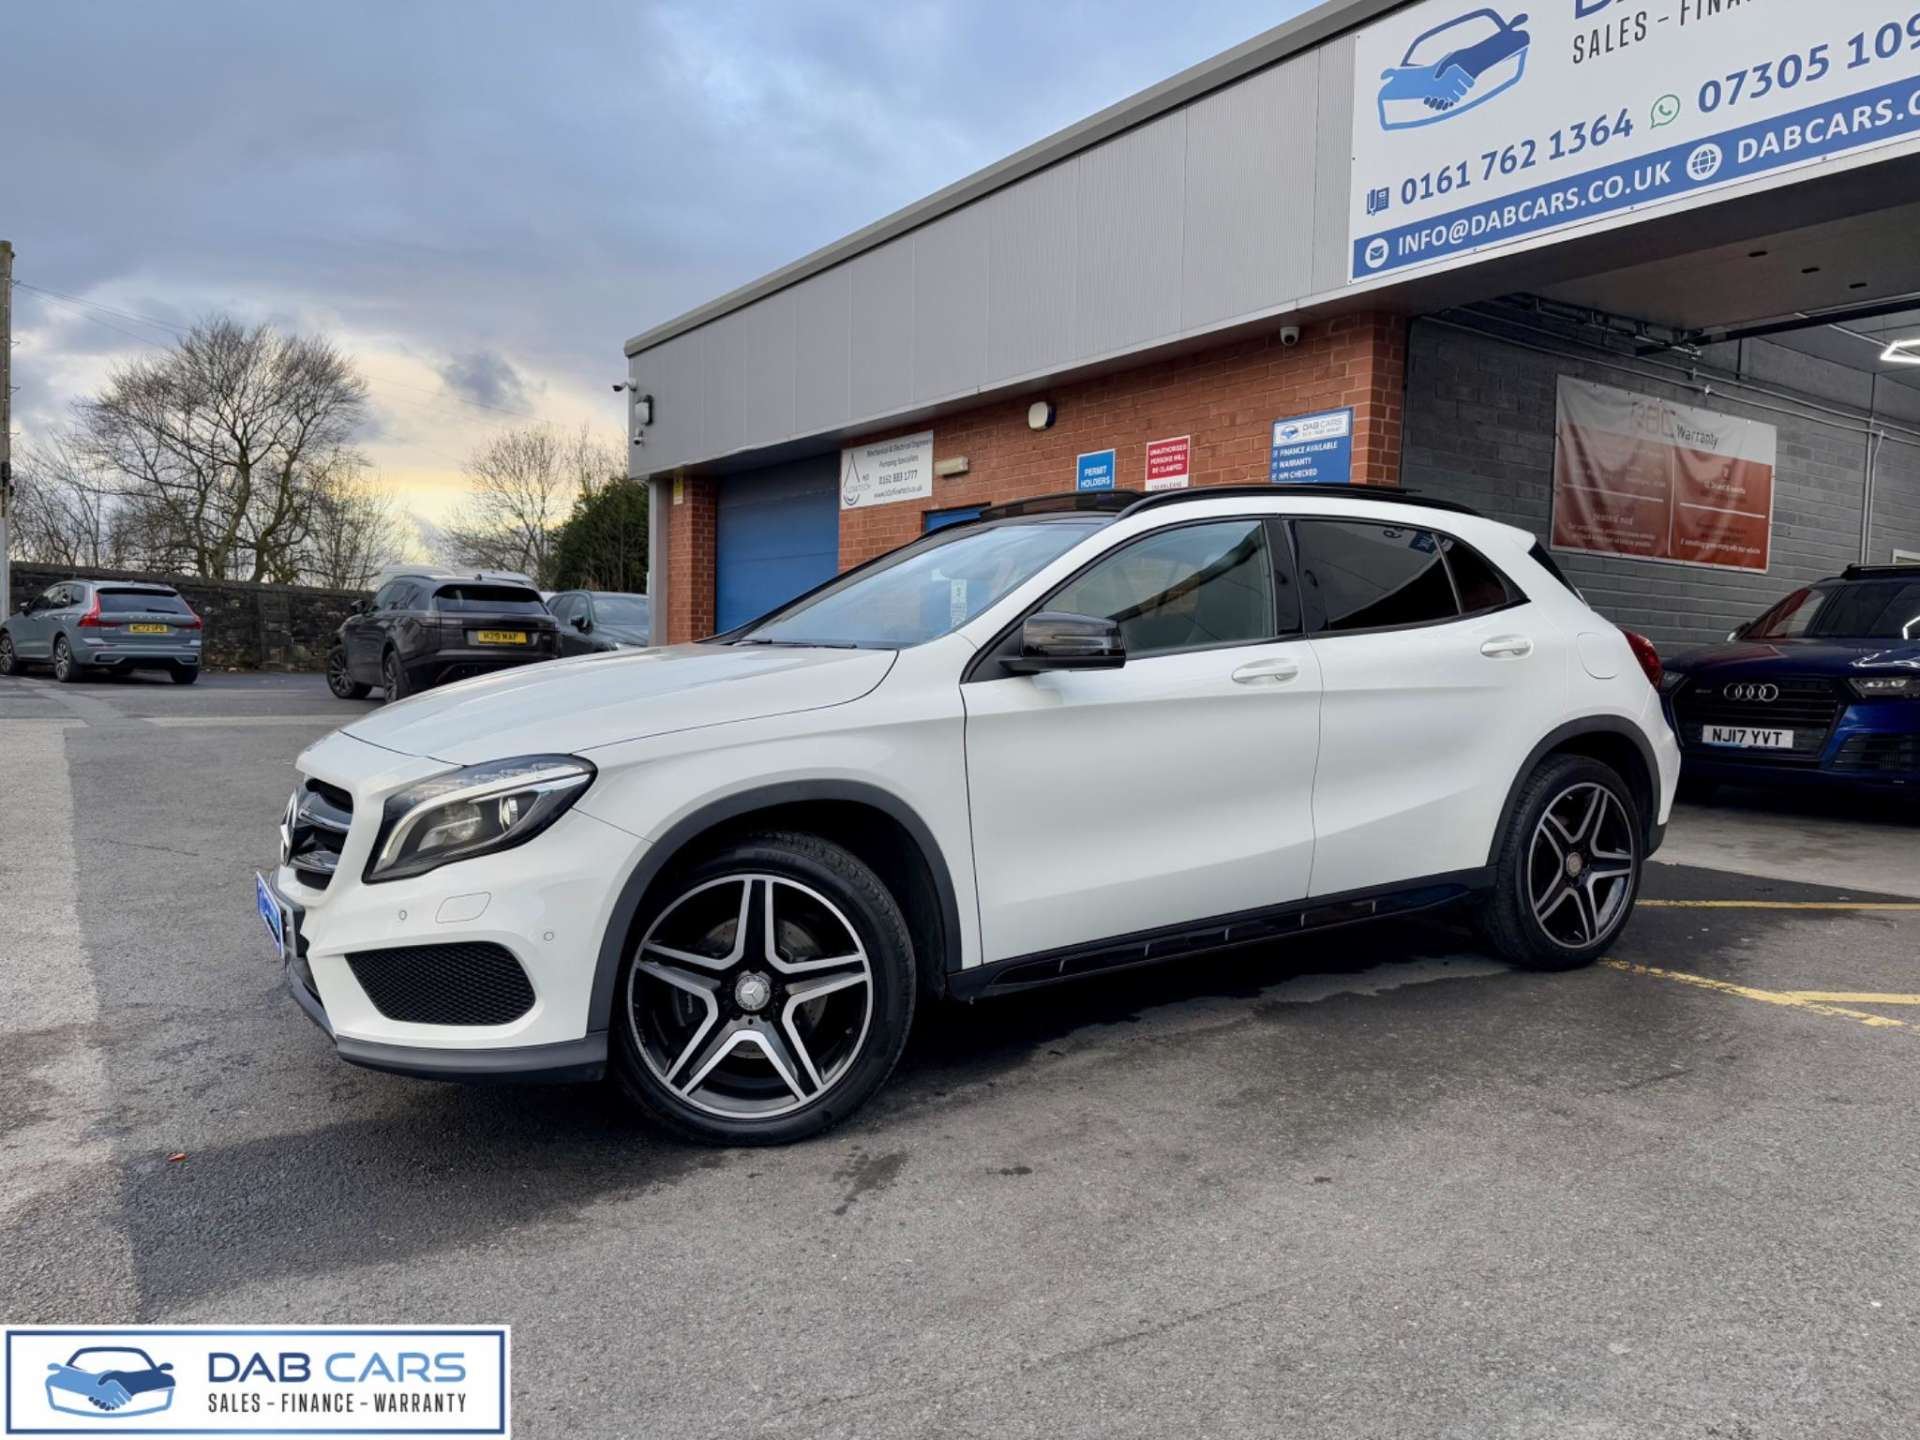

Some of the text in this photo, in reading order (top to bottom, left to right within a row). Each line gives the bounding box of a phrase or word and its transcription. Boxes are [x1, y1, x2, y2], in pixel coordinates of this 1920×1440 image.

[1572, 10, 1648, 64] SALES
[1400, 160, 1472, 205] 0161
[1480, 139, 1538, 182] 762
[1549, 108, 1634, 161] 1364
[1697, 43, 1830, 114] 07305
[1397, 160, 1673, 257] INFO@DABCARS.CO.UK
[1676, 423, 1720, 449] Warranty
[1279, 440, 1338, 457] FINANCE AVAILABLE
[1084, 464, 1108, 477] PERMIT
[1279, 457, 1312, 469] WARRANTY
[1080, 475, 1111, 489] HOLDERS
[1712, 727, 1783, 746] NJ17 YVT
